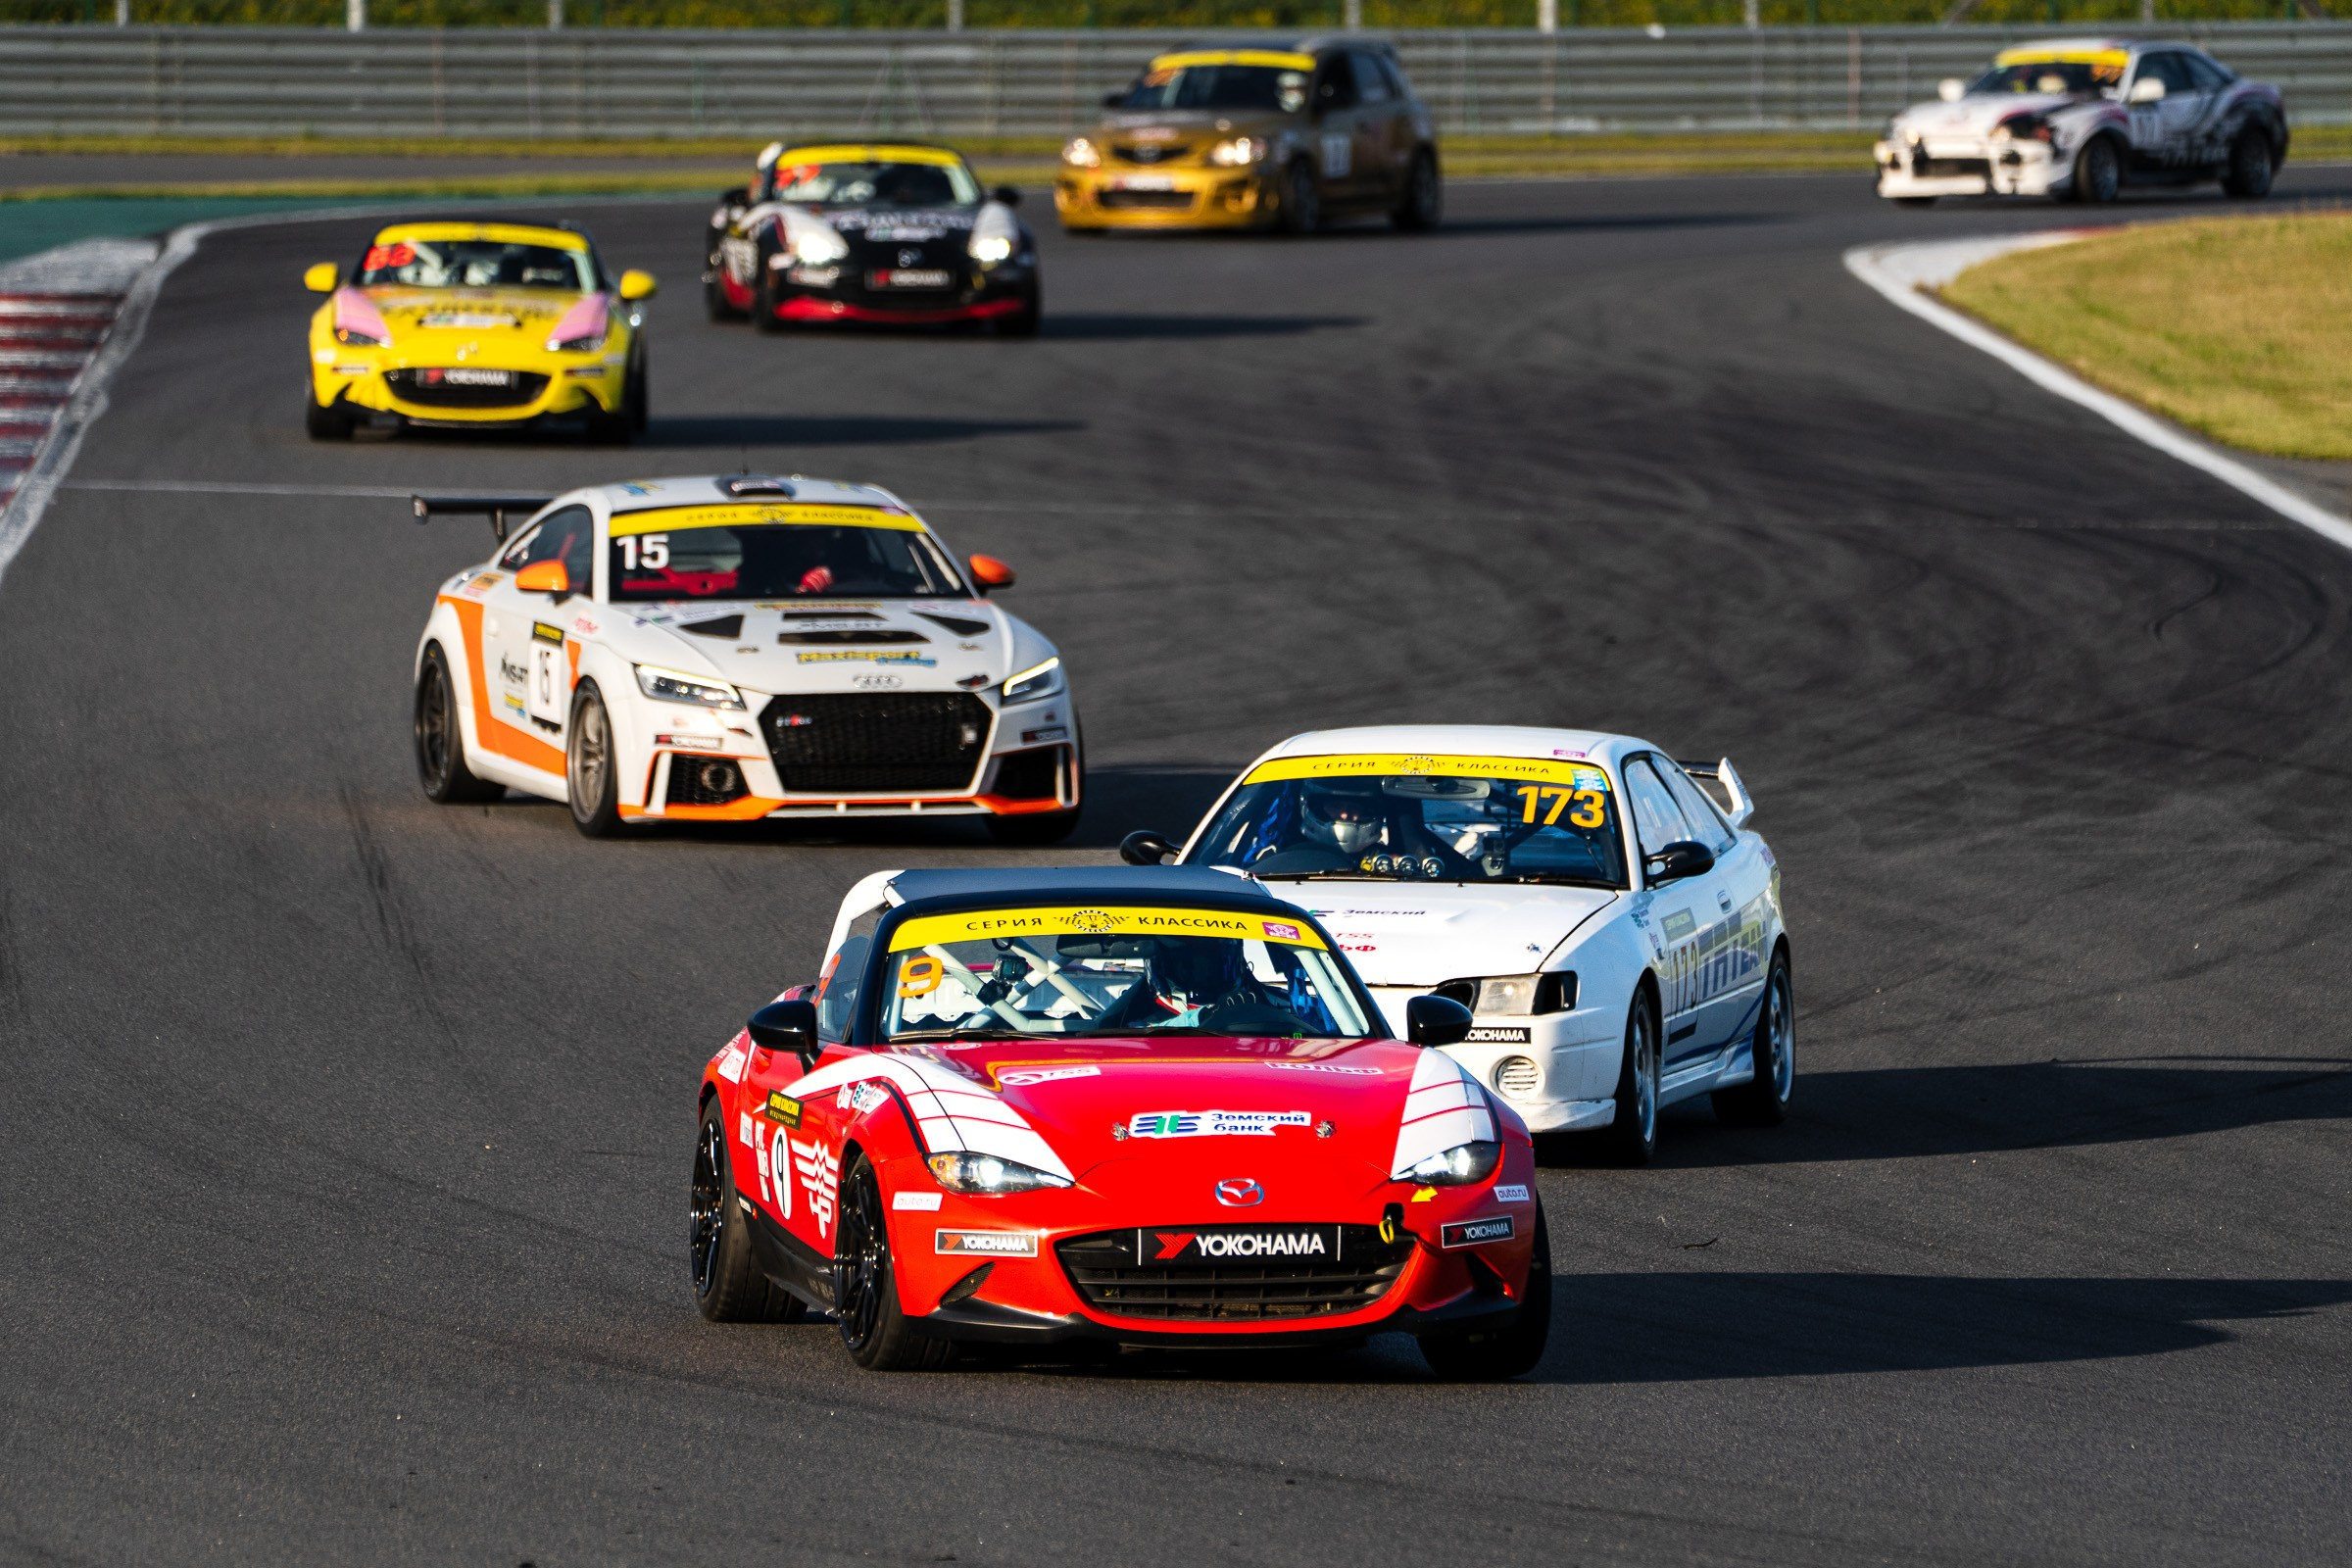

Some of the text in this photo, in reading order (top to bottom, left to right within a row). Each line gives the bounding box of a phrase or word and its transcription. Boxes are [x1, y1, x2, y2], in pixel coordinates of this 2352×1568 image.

[616, 535, 670, 570] 15
[1313, 760, 1550, 774] СЕРИЯ КЛАССИКА
[1517, 786, 1605, 828] 173
[965, 917, 1043, 931] СЕРИЯ
[1138, 916, 1249, 931] КЛАССИКА
[899, 956, 944, 999] 9
[1465, 1029, 1525, 1042] OKOHAMA
[1211, 1112, 1305, 1123] Земский
[1214, 1123, 1265, 1133] банк
[1497, 1189, 1528, 1200] auto.ru
[1464, 1222, 1511, 1239] YOKOHAMA
[963, 1237, 1029, 1251] YOKOHAMA
[1197, 1234, 1326, 1257] YOKOHAMA
